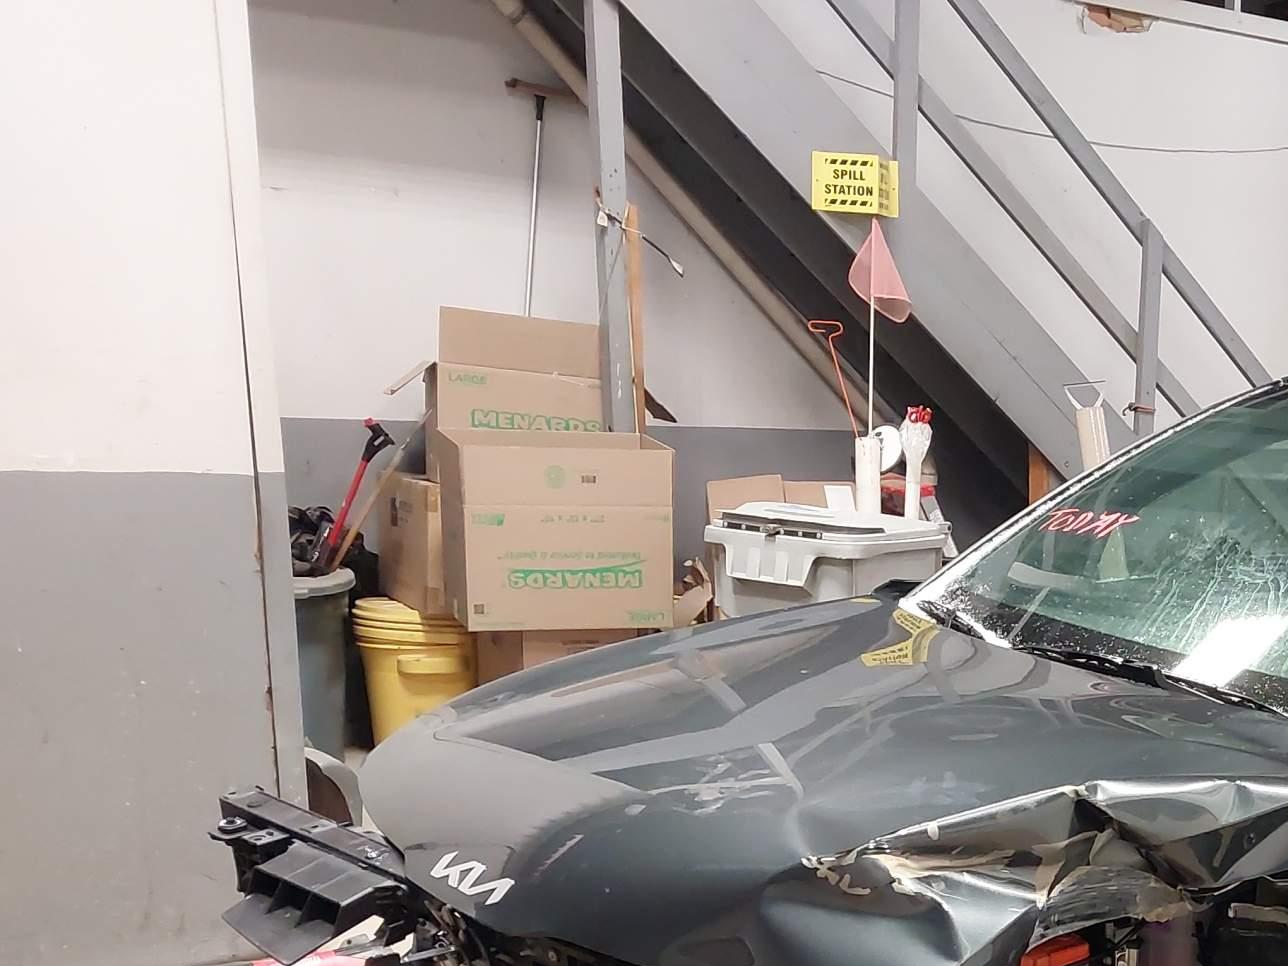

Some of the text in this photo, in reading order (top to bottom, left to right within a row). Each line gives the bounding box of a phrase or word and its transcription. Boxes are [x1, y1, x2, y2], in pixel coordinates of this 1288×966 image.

[833, 169, 866, 181] SPILL
[824, 184, 873, 197] STATION
[471, 409, 601, 432] MENARDS
[1038, 508, 1140, 539] TODAY
[508, 569, 643, 588] MENARDS
